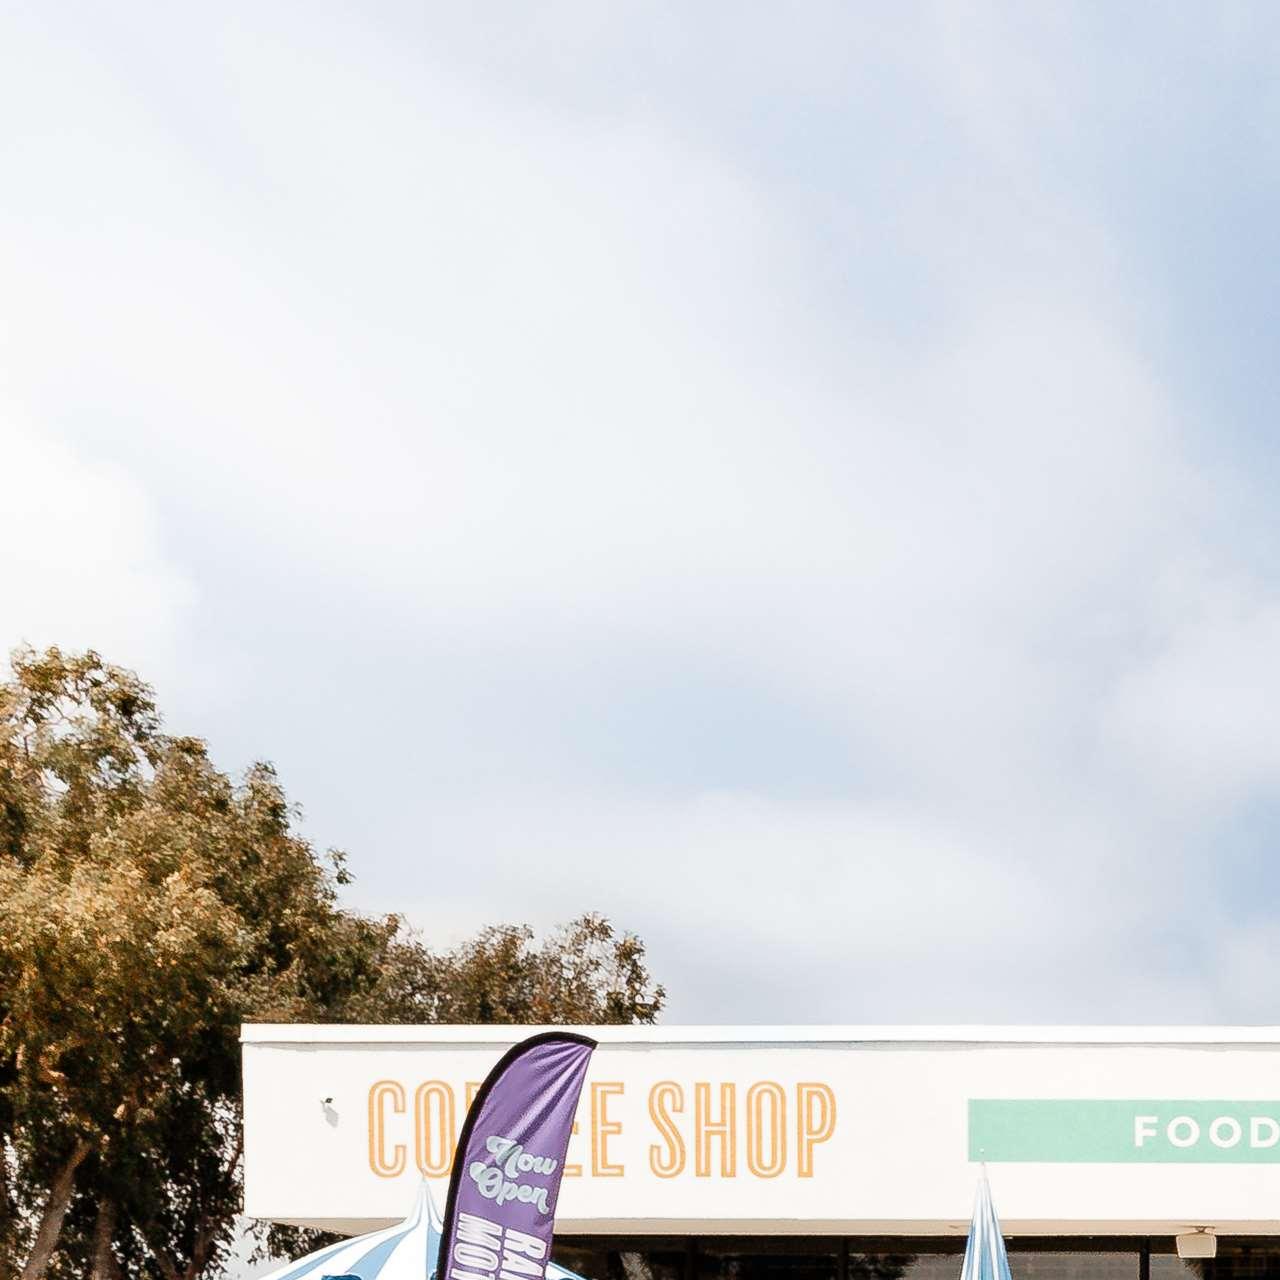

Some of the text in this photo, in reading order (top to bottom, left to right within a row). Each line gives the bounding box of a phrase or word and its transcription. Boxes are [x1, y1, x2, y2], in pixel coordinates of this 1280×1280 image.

[367, 1080, 837, 1178] COE SHOP
[1134, 1116, 1280, 1148] FOOD
[486, 1135, 558, 1179] Now
[469, 1161, 551, 1216] Open
